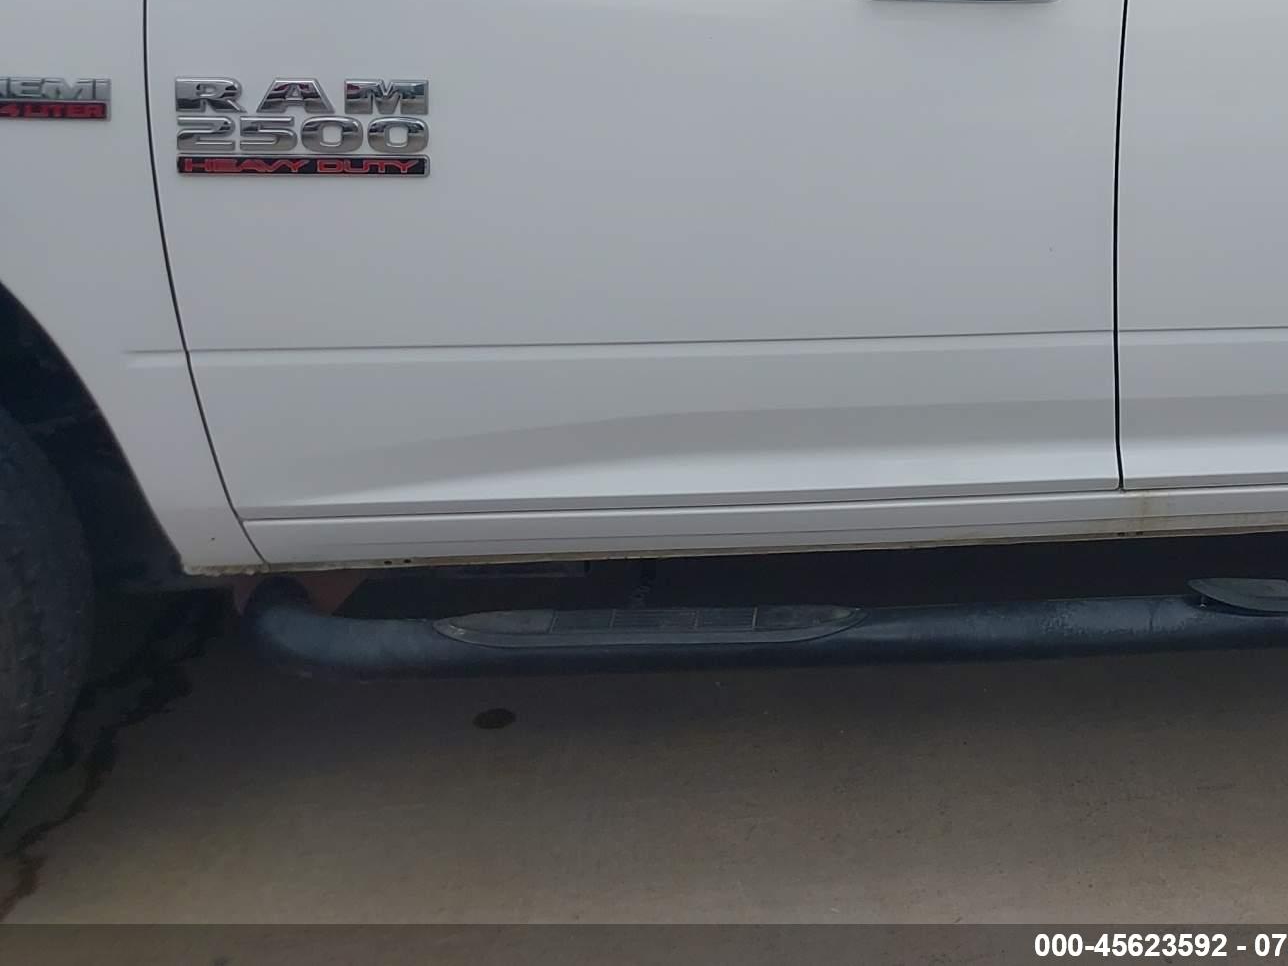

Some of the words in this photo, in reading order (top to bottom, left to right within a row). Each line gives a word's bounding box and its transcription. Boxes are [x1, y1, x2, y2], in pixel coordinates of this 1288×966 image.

[175, 77, 429, 114] RAM
[23, 103, 106, 119] LITER
[176, 115, 429, 153] 2500
[183, 158, 305, 173] HEAVY
[316, 159, 418, 174] DUTY
